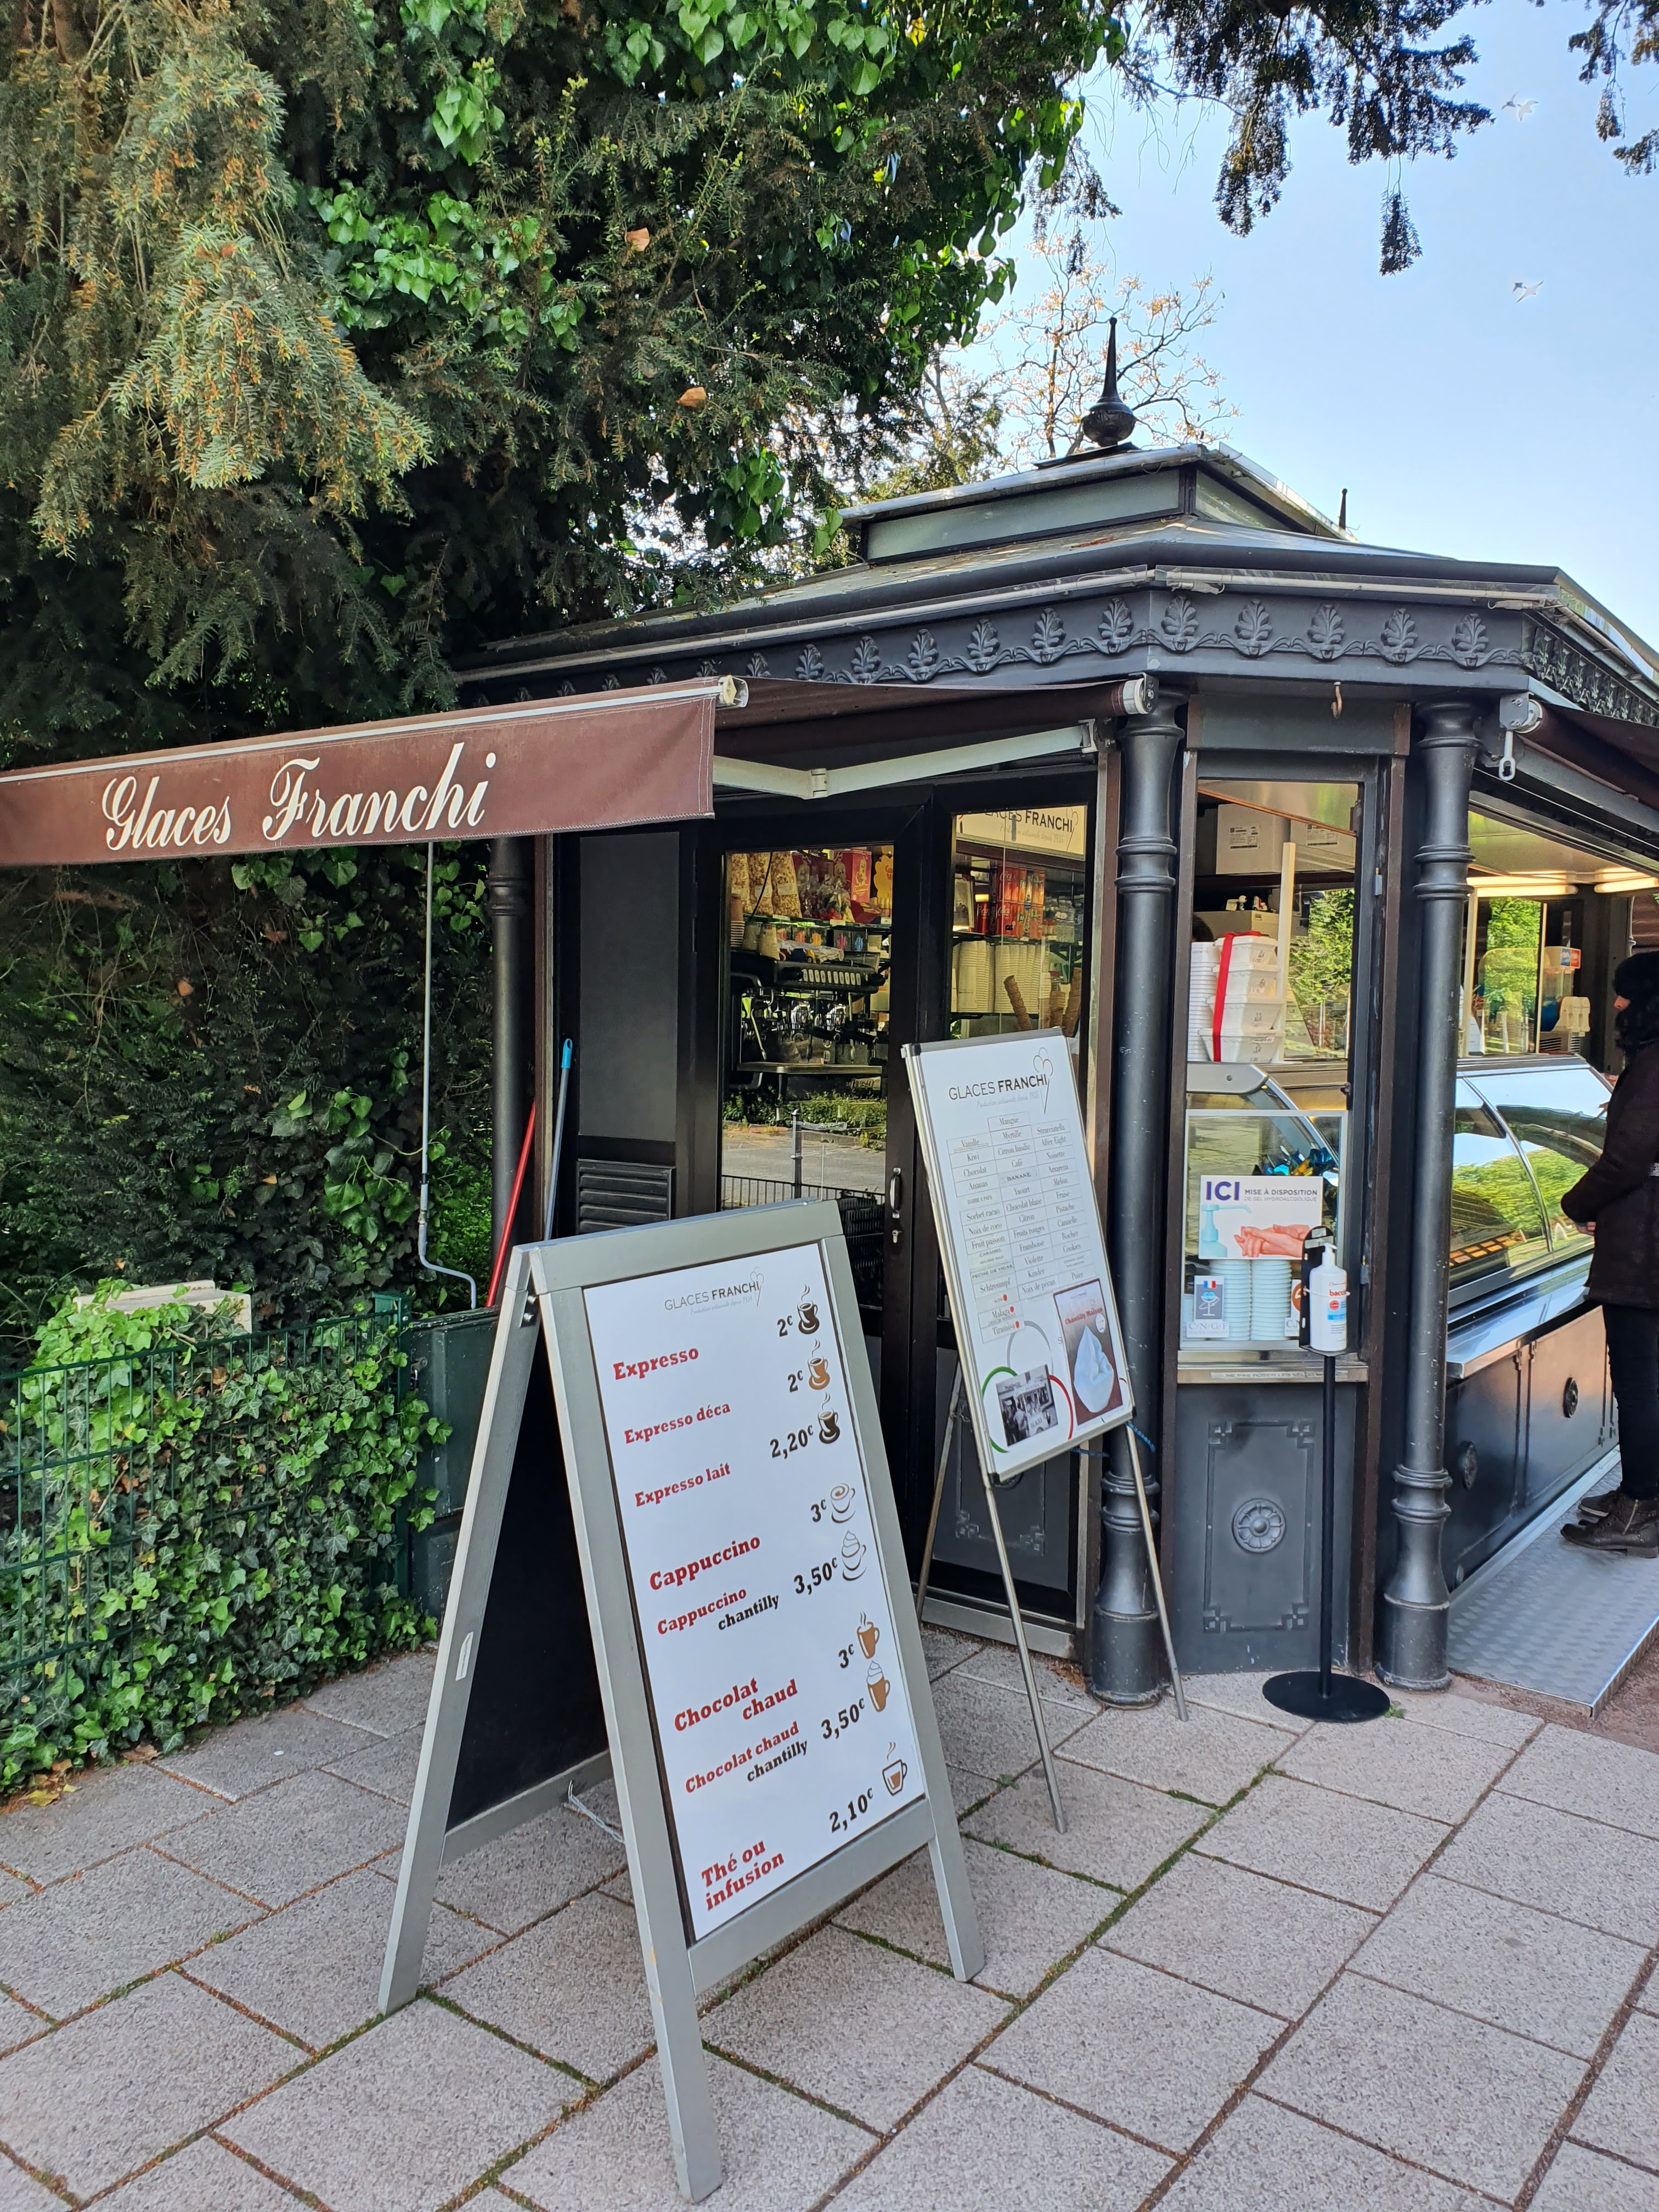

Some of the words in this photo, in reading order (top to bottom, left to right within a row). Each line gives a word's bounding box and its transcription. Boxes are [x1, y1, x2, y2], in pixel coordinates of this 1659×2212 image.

[102, 776, 231, 851] Glaces
[263, 742, 497, 841] Franchi
[1025, 810, 1072, 832] FRANCHI
[949, 1081, 995, 1101] GLACES
[997, 1074, 1048, 1093] FRANCHI
[999, 1117, 1019, 1127] Mangue
[1037, 1124, 1065, 1135] Stracciatella
[1002, 1130, 1022, 1141] Myrtille
[1041, 1138, 1053, 1146] After
[1054, 1136, 1066, 1146] Eight
[961, 1138, 980, 1149] Vanille
[998, 1146, 1015, 1155] Citron
[1015, 1143, 1031, 1153] basilic
[967, 1153, 979, 1162] Kiwi
[1046, 1151, 1065, 1159] Noisette
[1011, 1159, 1023, 1168] Café
[1048, 1164, 1069, 1173] Amarena
[963, 1167, 987, 1177] Chocolat
[1007, 1172, 1031, 1181] BANANE
[969, 1182, 988, 1190] Ananas
[1053, 1177, 1068, 1186] Melon
[1014, 1186, 1030, 1195] Yaourt
[1056, 1191, 1070, 1199] Fraise
[1206, 1181, 1240, 1201] ICI
[1006, 1200, 1029, 1211] Chocolat
[1029, 1198, 1042, 1206] blanc
[1056, 1203, 1075, 1214] Pistache
[966, 1210, 985, 1221] Sorbet
[1019, 1214, 1035, 1223] Citron
[1057, 1216, 1077, 1227] Cannelle
[968, 1227, 982, 1236] Noix
[1013, 1229, 1028, 1238] Fruits
[1029, 1226, 1045, 1235] rouges
[1062, 1231, 1079, 1240] Rocher
[971, 1239, 985, 1249] Fruit
[986, 1235, 1005, 1247] passion
[1019, 1240, 1045, 1252] Framboise
[979, 1249, 1002, 1257] CARAMEL
[1063, 1244, 1081, 1253] Cookies
[1024, 1255, 1043, 1265] Violette
[1028, 1268, 1045, 1278] Kinder
[1071, 1272, 1084, 1280] Poire
[980, 1277, 1011, 1293] Schtroumpf
[1022, 1286, 1034, 1295] Noix
[1041, 1279, 1056, 1289] pécan
[664, 1291, 709, 1310] GLACES
[712, 1280, 760, 1300] FRANCHI
[613, 1347, 699, 1380] Expresso
[624, 1415, 693, 1444] Expresso
[696, 1403, 731, 1421] déca
[634, 1472, 703, 1507] Expresso
[706, 1462, 731, 1482] lait
[650, 1536, 760, 1590] Cappuccino
[657, 1589, 747, 1635] Cappuccino
[718, 1594, 779, 1630] chantilly
[674, 1677, 759, 1731] Chocolat
[742, 1679, 798, 1720] chaud
[685, 1747, 753, 1793] Chocolat
[754, 1720, 799, 1756] chaud
[746, 1740, 808, 1782] chantilly
[701, 1852, 738, 1888] Thé
[741, 1841, 766, 1864] ou
[705, 1852, 785, 1912] infusion
